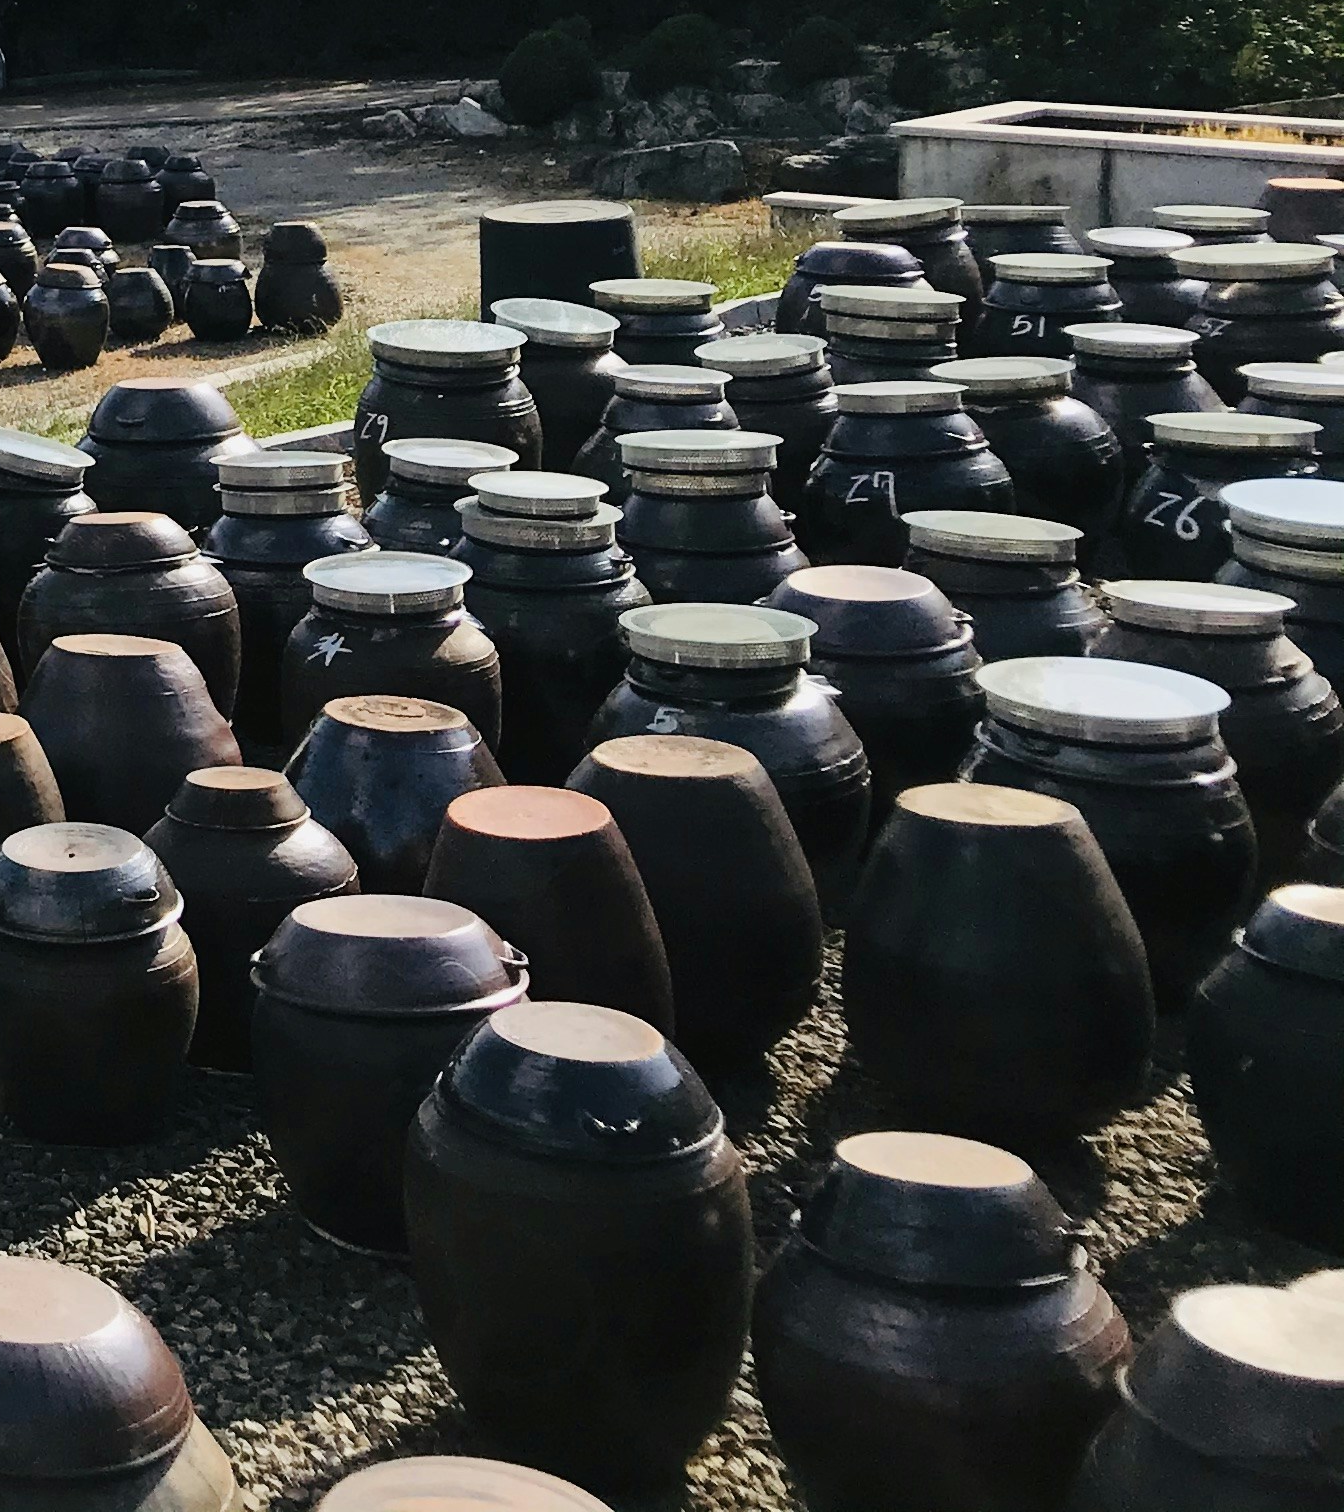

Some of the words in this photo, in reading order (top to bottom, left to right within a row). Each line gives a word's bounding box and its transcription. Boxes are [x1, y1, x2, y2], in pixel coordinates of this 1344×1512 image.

[1011, 314, 1045, 338] 51
[360, 412, 389, 443] 29
[1144, 491, 1206, 541] 26
